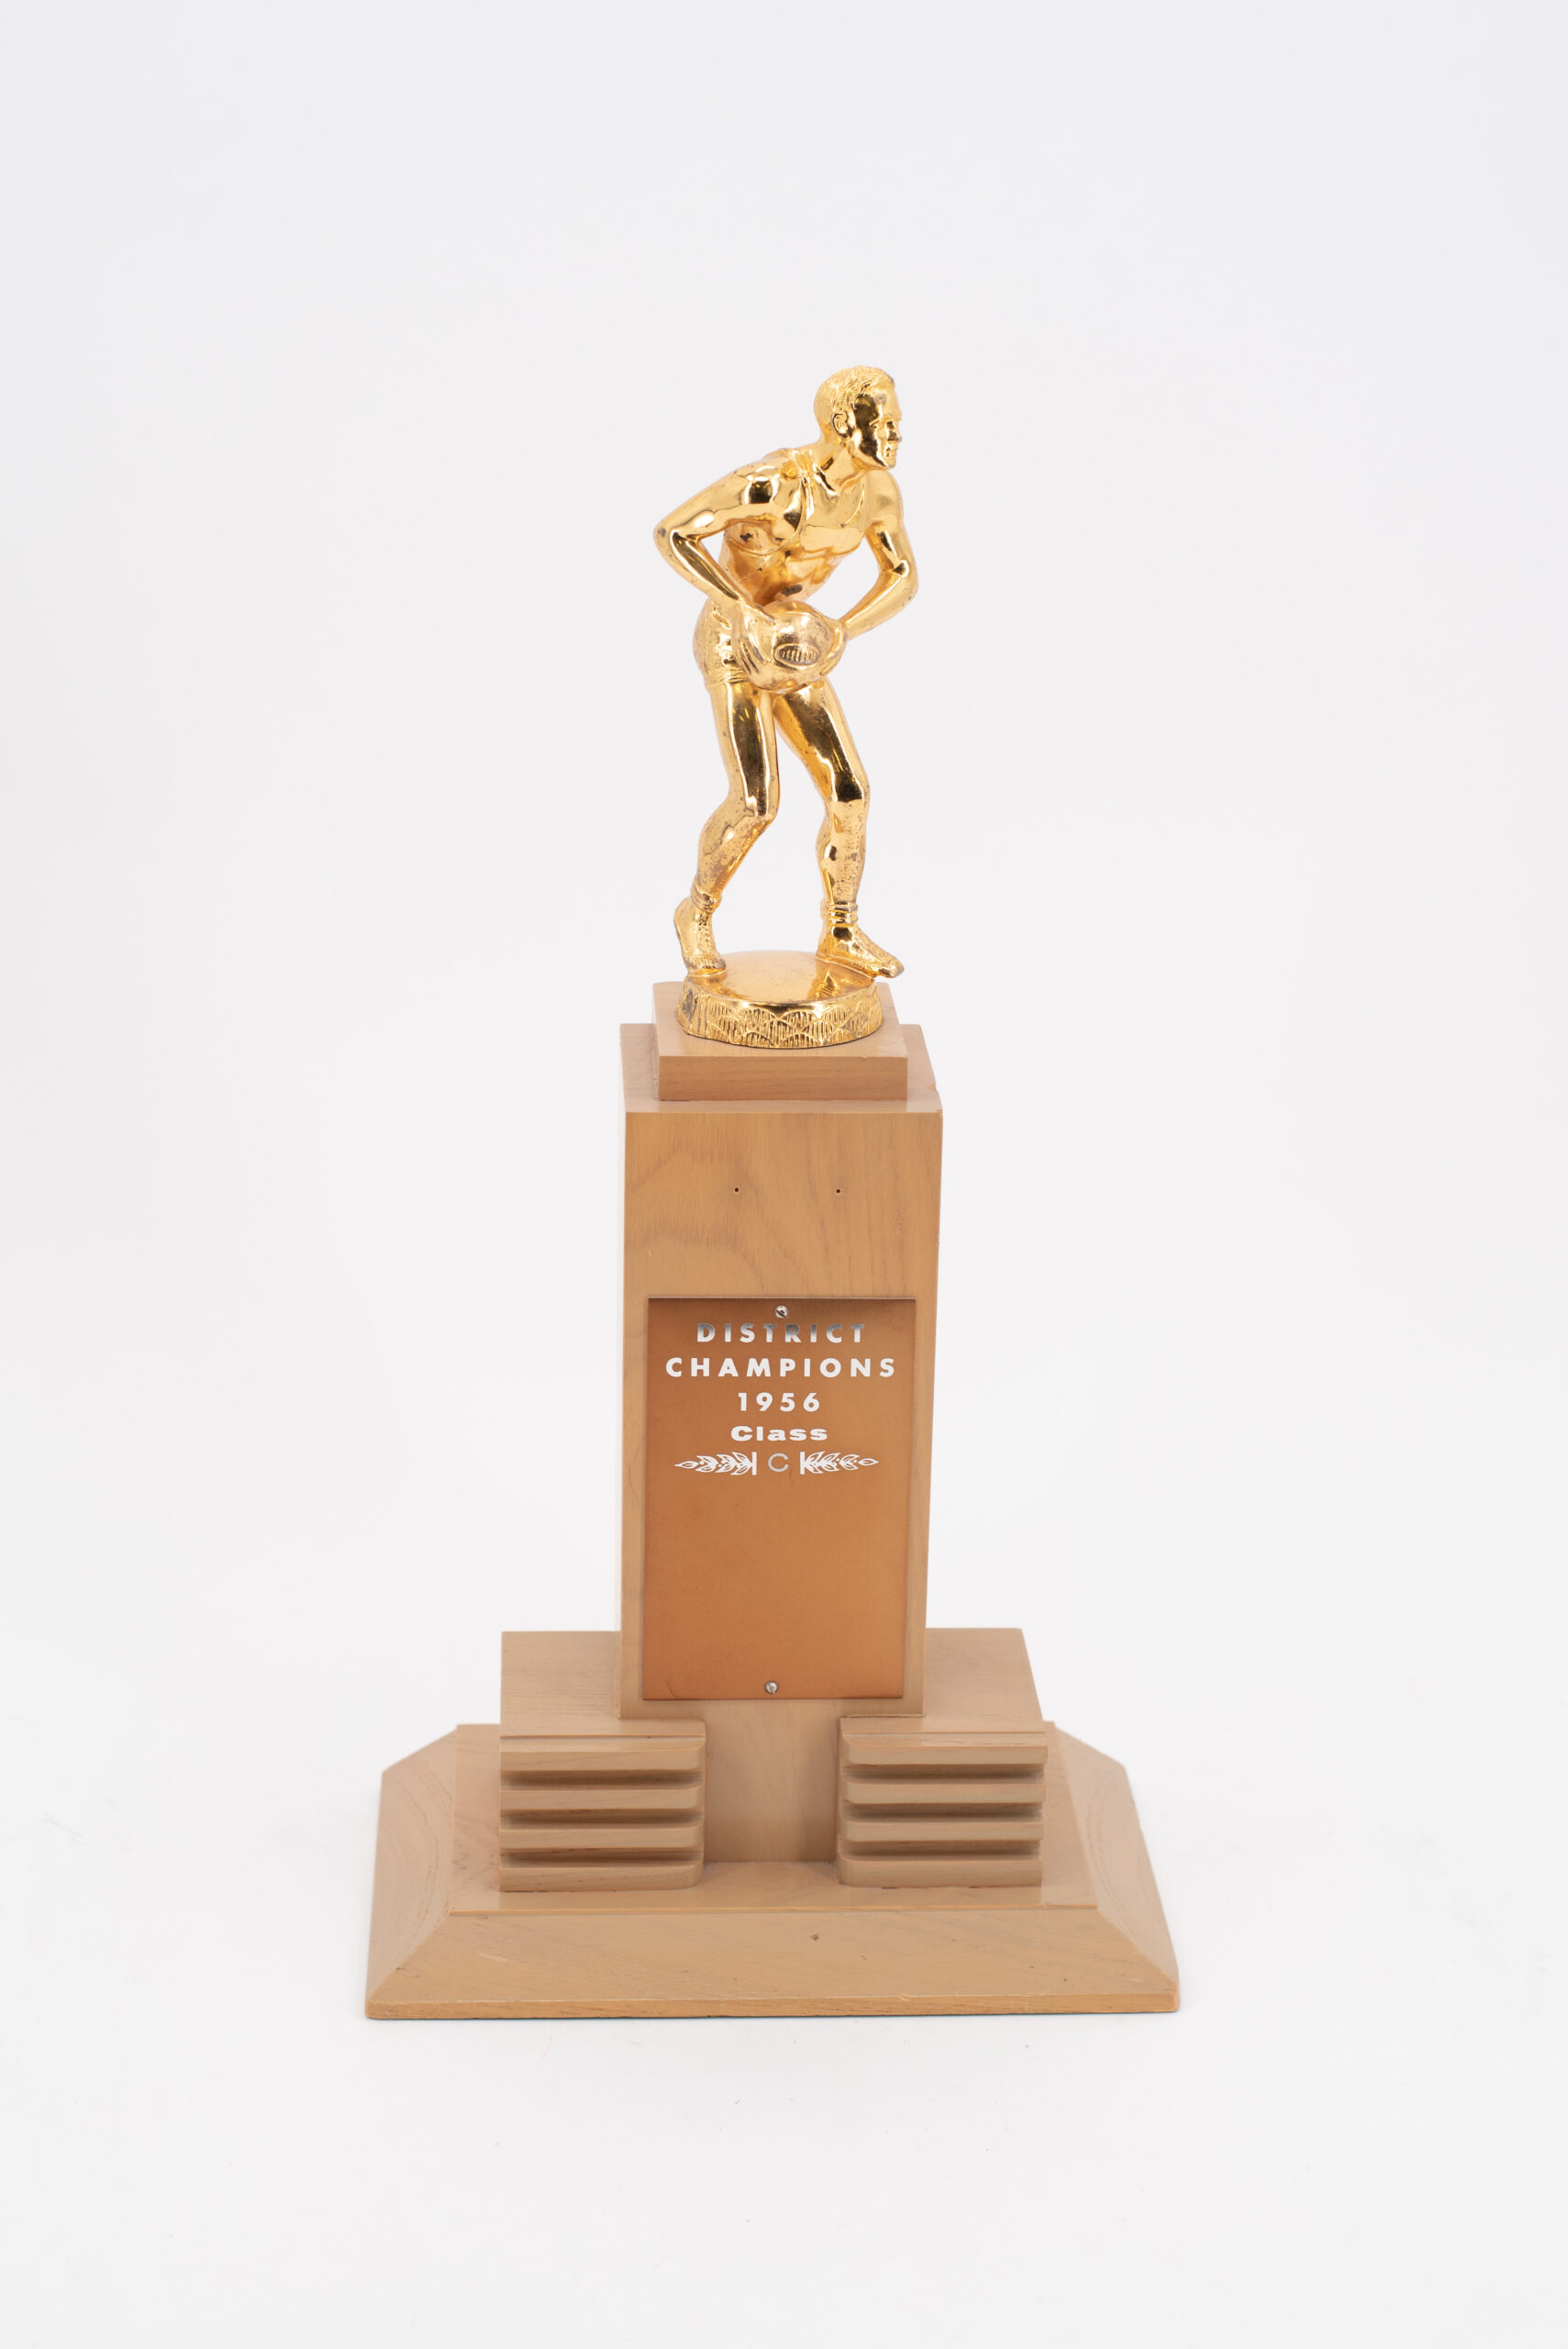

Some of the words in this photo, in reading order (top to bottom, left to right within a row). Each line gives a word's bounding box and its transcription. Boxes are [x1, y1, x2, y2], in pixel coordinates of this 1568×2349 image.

[697, 1323, 865, 1343] DISTRICT
[665, 1357, 895, 1378] CHAMPIONS
[738, 1392, 820, 1412] 1956
[730, 1425, 828, 1442] Class
[768, 1453, 789, 1473] C
